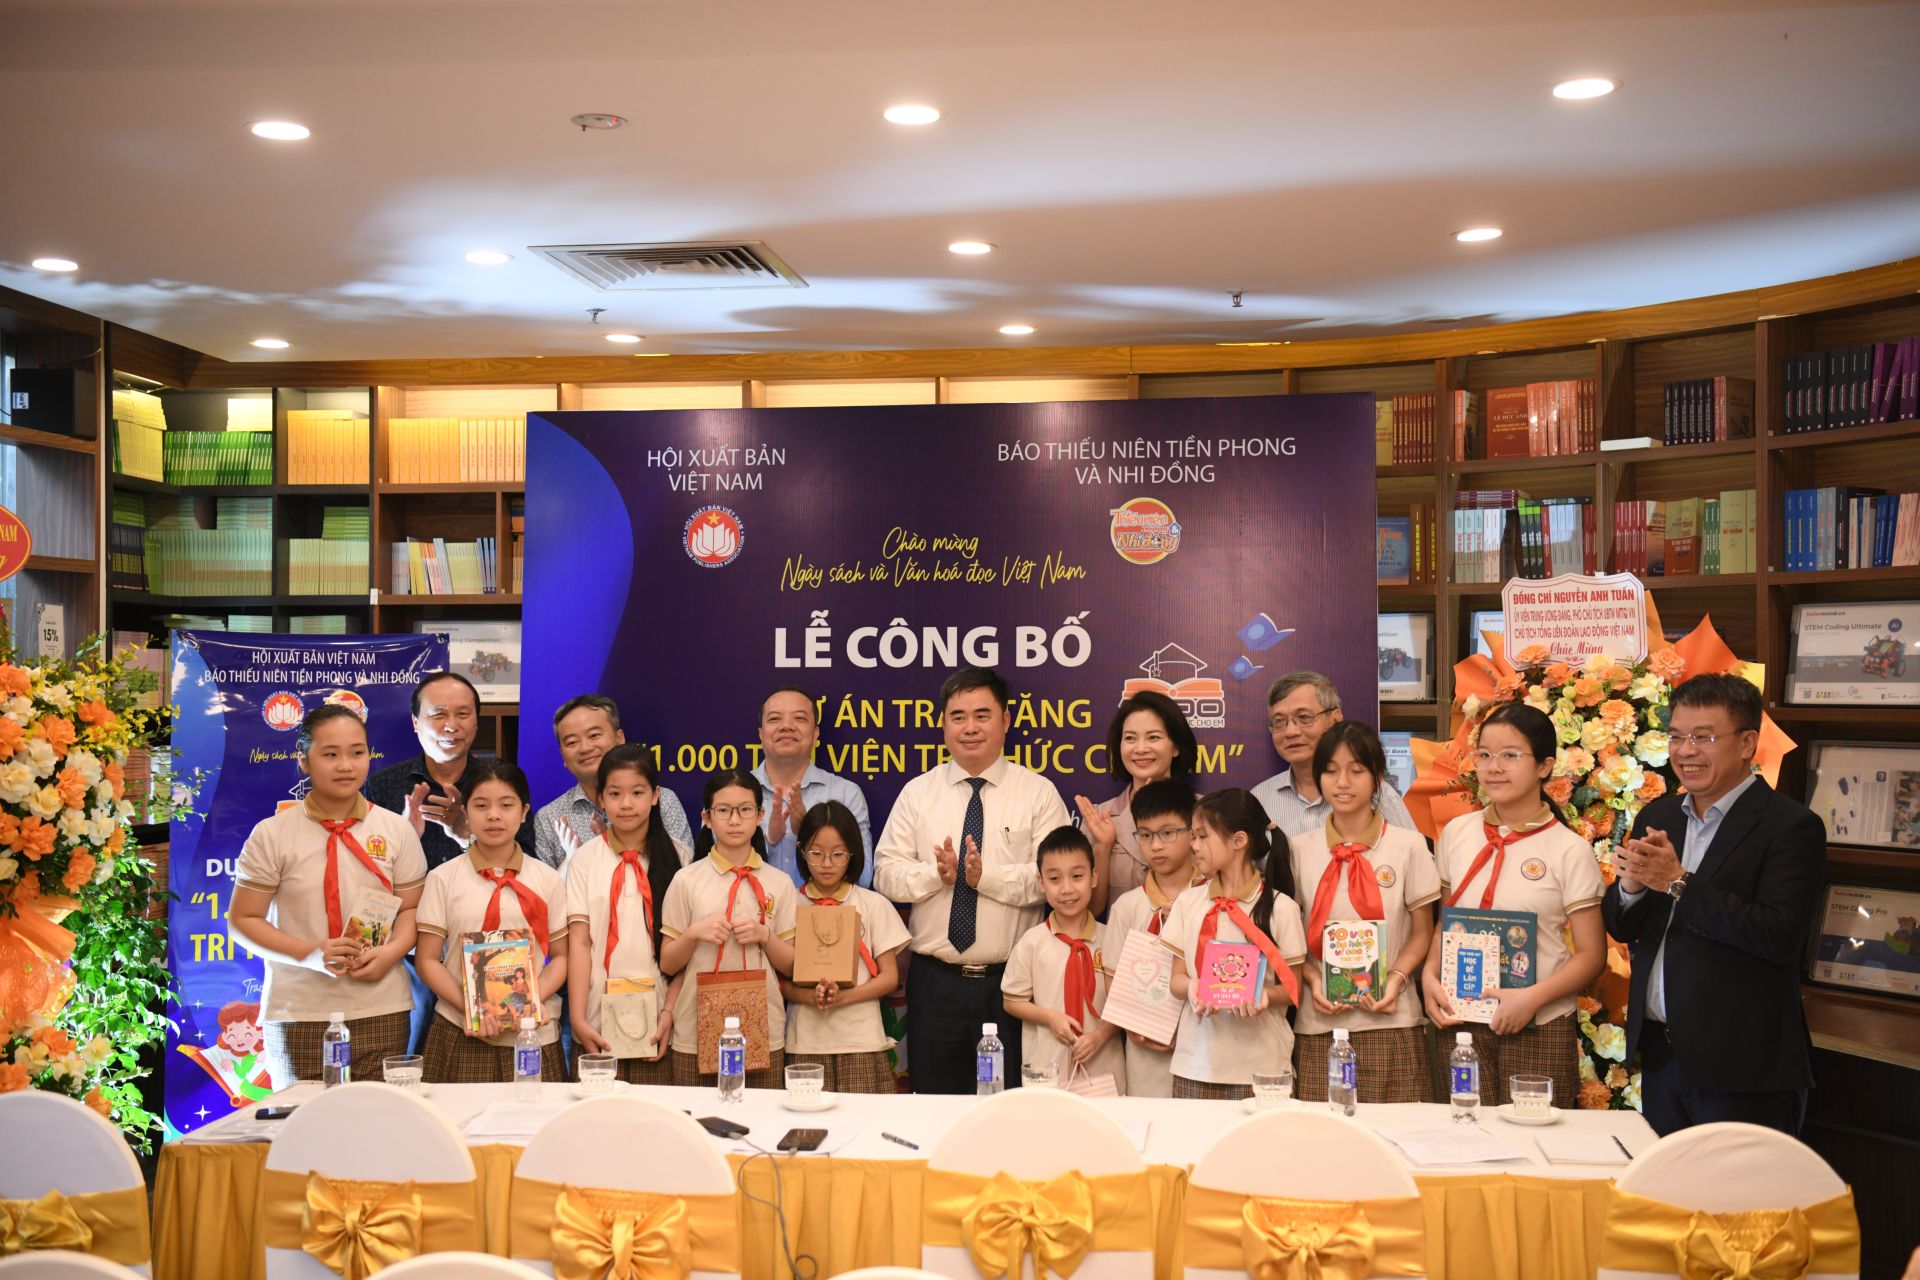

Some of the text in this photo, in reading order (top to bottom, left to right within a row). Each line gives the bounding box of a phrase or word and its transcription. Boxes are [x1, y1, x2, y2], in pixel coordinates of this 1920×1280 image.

[647, 443, 786, 471] HỘI XUẤT BẢN
[998, 435, 1296, 462] BÁO THIẾU NIÊN TIỀN PHONG
[669, 471, 763, 494] VIỆT NAM
[1075, 460, 1215, 484] VÀ NHI ĐỒNG
[883, 526, 979, 559] Chào mừng
[780, 550, 1087, 592] Ngày sách và Văn hoá đọc Việt Nam
[1513, 585, 1635, 605] ĐỒNG CHÍ NGUYỄN ANH TUẤN
[43, 628, 59, 642] 15%
[774, 609, 1092, 668] LỄ CÔNG BỐ
[1580, 625, 1591, 638] LAO
[1623, 625, 1635, 637] NAM
[1824, 624, 1850, 632] Coding
[1851, 623, 1883, 631] Ultimate
[252, 647, 376, 667] HỘI XUẤT BẢN VIỆT NAM
[204, 668, 226, 683] BÁO
[228, 667, 260, 683] THIẾU
[262, 669, 287, 683] NIÊN
[290, 667, 312, 684] TIỀN
[316, 671, 352, 684] PHONG
[370, 671, 388, 684] NHI
[390, 668, 420, 684] ĐỒNG
[834, 693, 884, 729] ÁN
[827, 738, 906, 781] VIỆN
[1001, 737, 1074, 774] HỨC
[1463, 957, 1477, 966] HỌC
